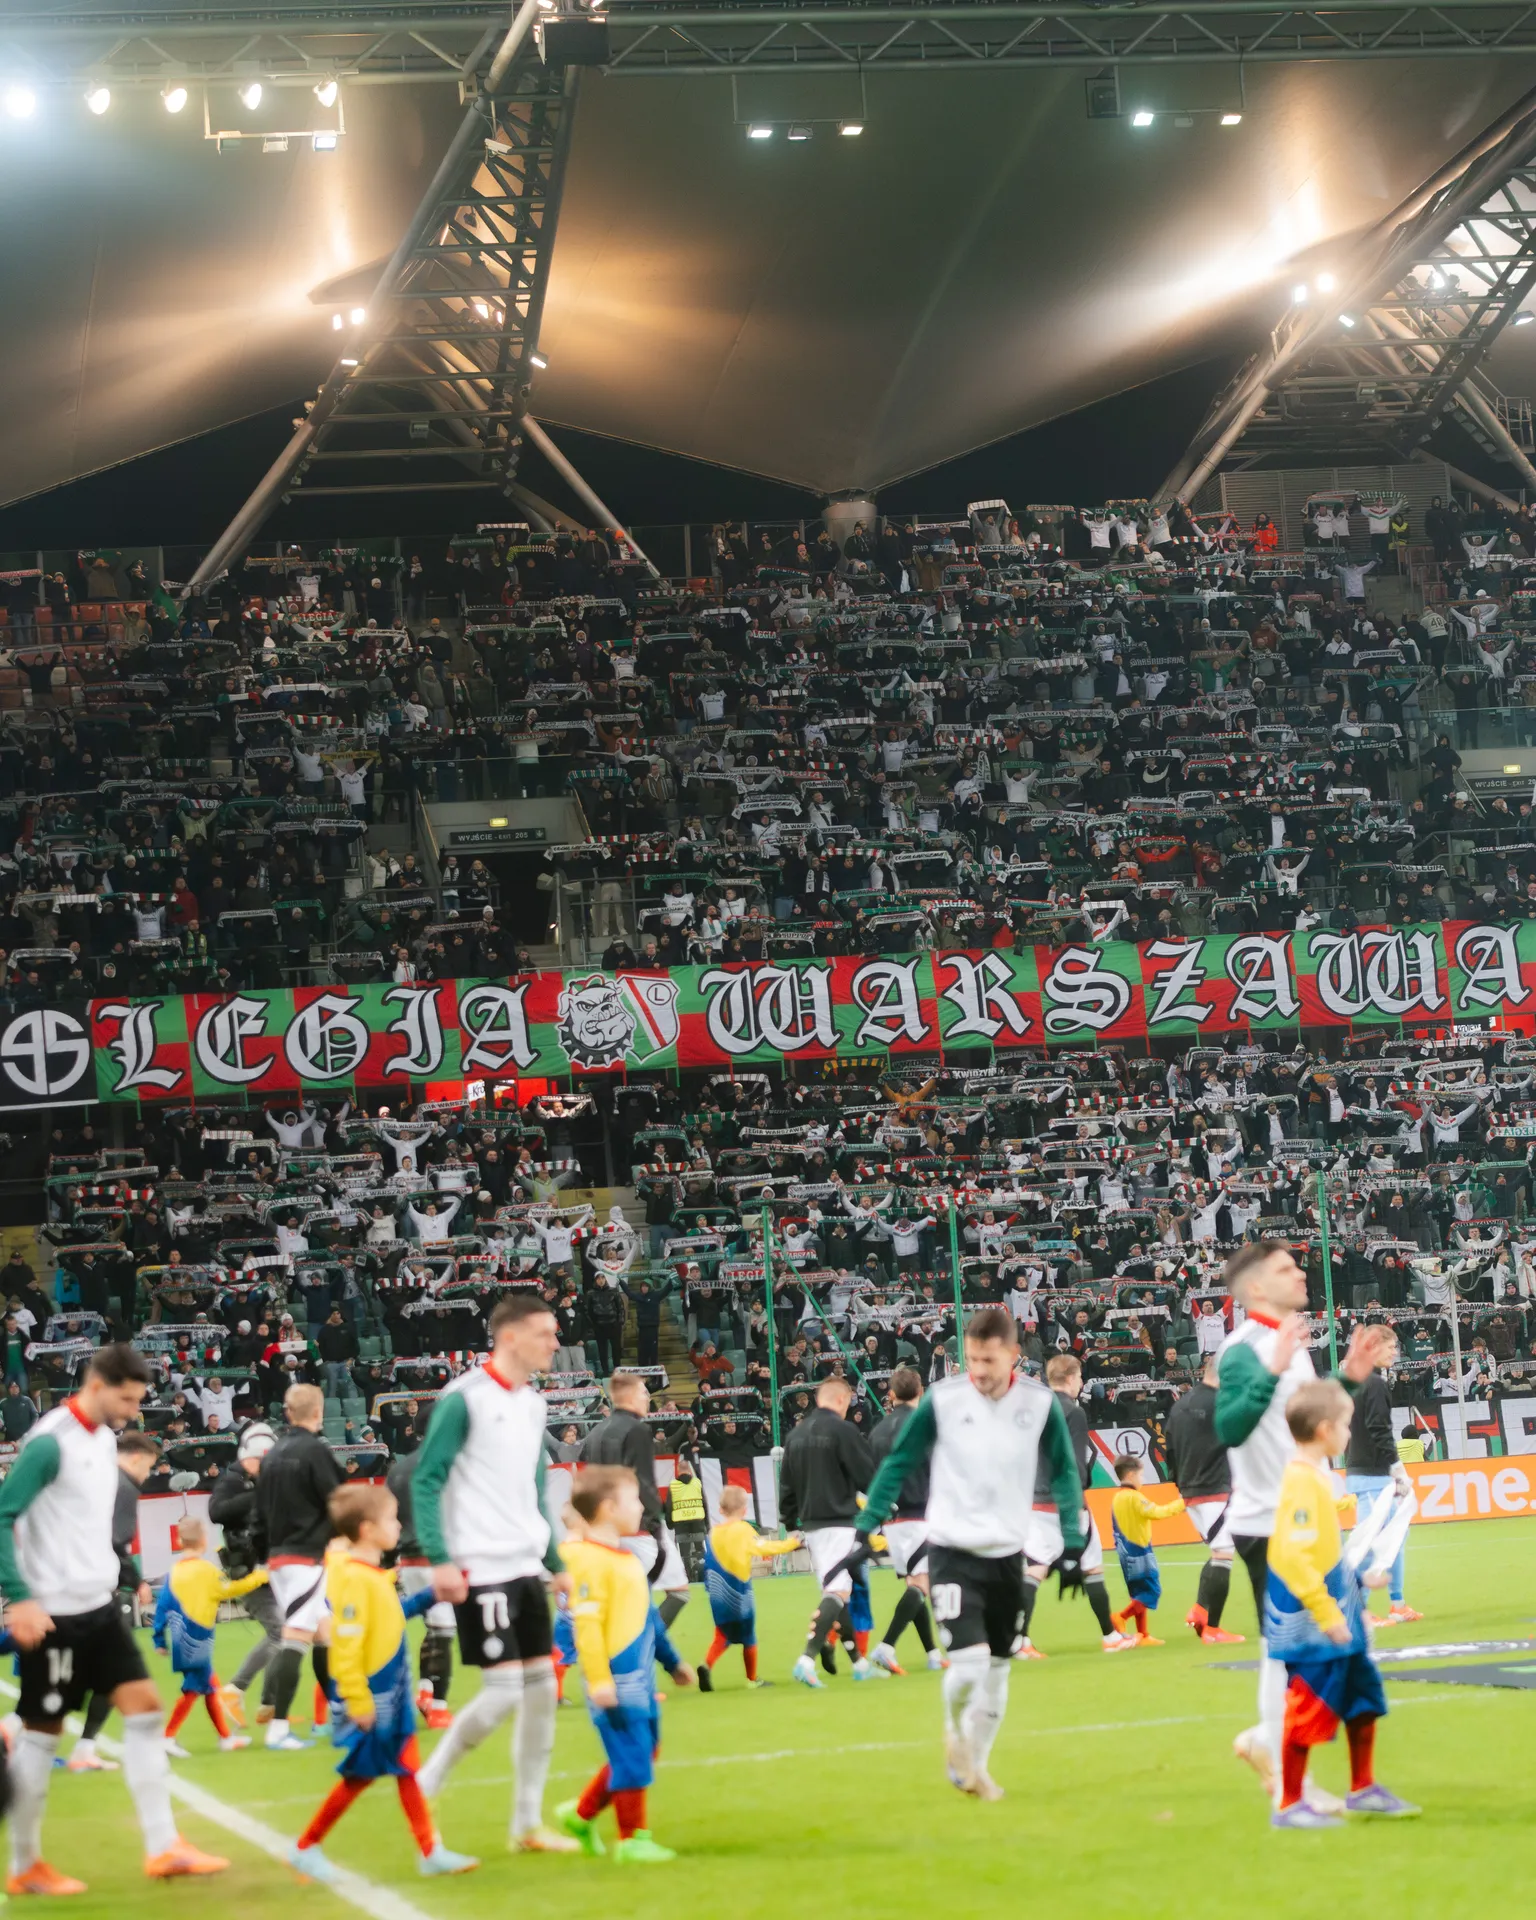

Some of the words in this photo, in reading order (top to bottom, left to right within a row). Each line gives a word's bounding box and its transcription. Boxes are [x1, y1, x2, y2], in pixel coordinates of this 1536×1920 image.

[302, 612, 334, 622] LEGIA
[753, 630, 777, 640] LEGIA
[1132, 749, 1173, 758] LEGIA
[457, 833, 493, 842] WYJŚCIE
[514, 831, 528, 839] 205
[936, 899, 968, 909] LEGIA
[98, 983, 541, 1092] LEGIA
[700, 921, 1532, 1054] WARSZAWA
[730, 1270, 767, 1282] LEGIA
[1125, 1435, 1138, 1455] L
[931, 1582, 963, 1622] 30
